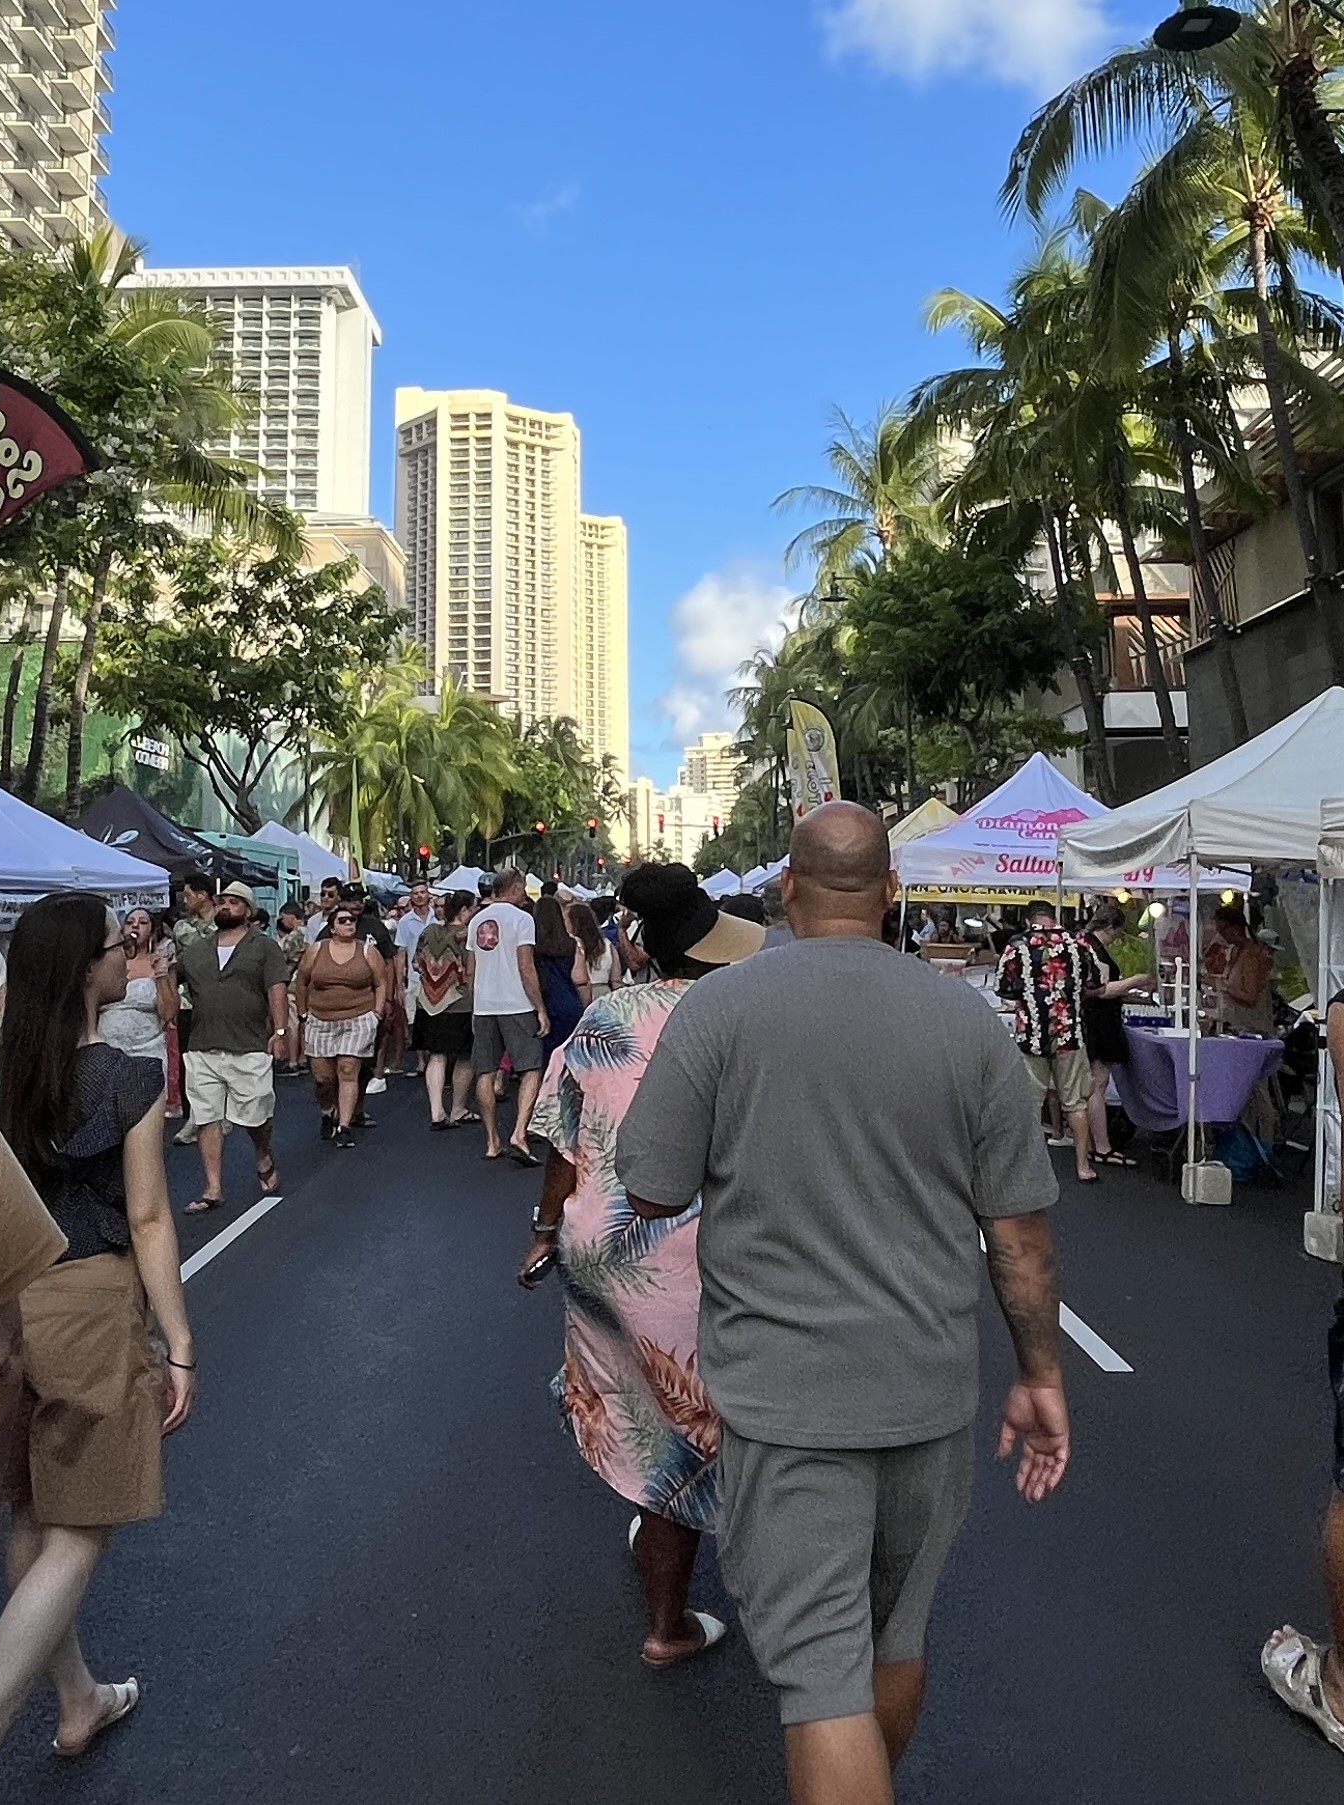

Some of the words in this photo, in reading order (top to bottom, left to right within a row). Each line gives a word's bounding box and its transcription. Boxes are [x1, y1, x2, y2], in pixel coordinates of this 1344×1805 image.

[976, 818, 1060, 831] Diamon
[1020, 829, 1057, 840] Can
[996, 853, 1061, 874] Saltw
